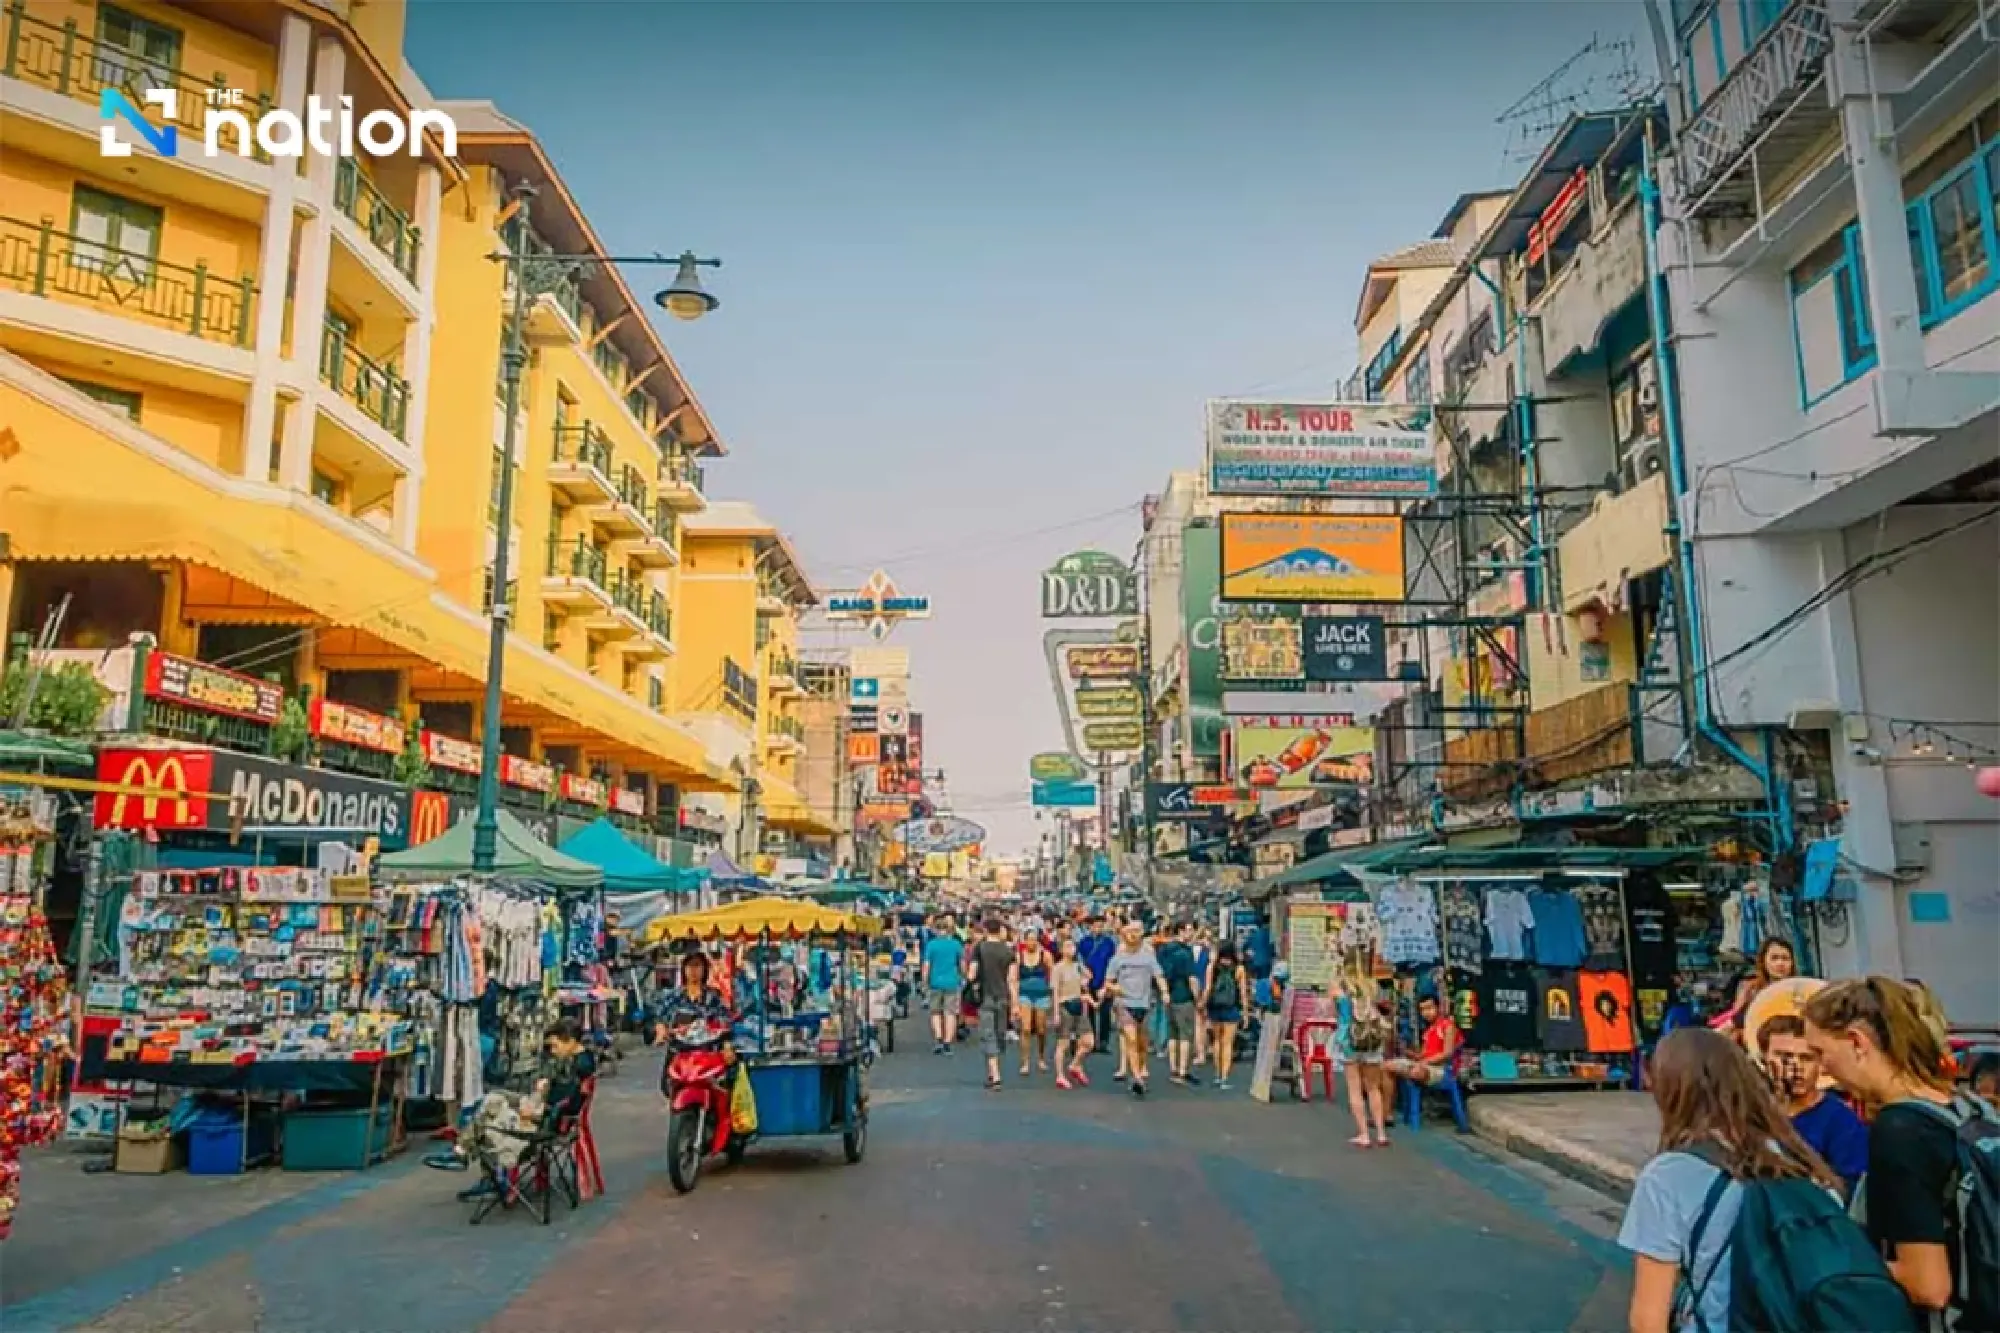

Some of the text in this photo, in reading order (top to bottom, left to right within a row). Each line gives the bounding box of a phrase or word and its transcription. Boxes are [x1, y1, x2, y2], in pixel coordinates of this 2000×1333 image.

[1245, 408, 1354, 432] N.S. TOUR
[1048, 574, 1121, 614] D&D
[1315, 622, 1371, 642] JACK
[227, 768, 401, 836] McDonald's
